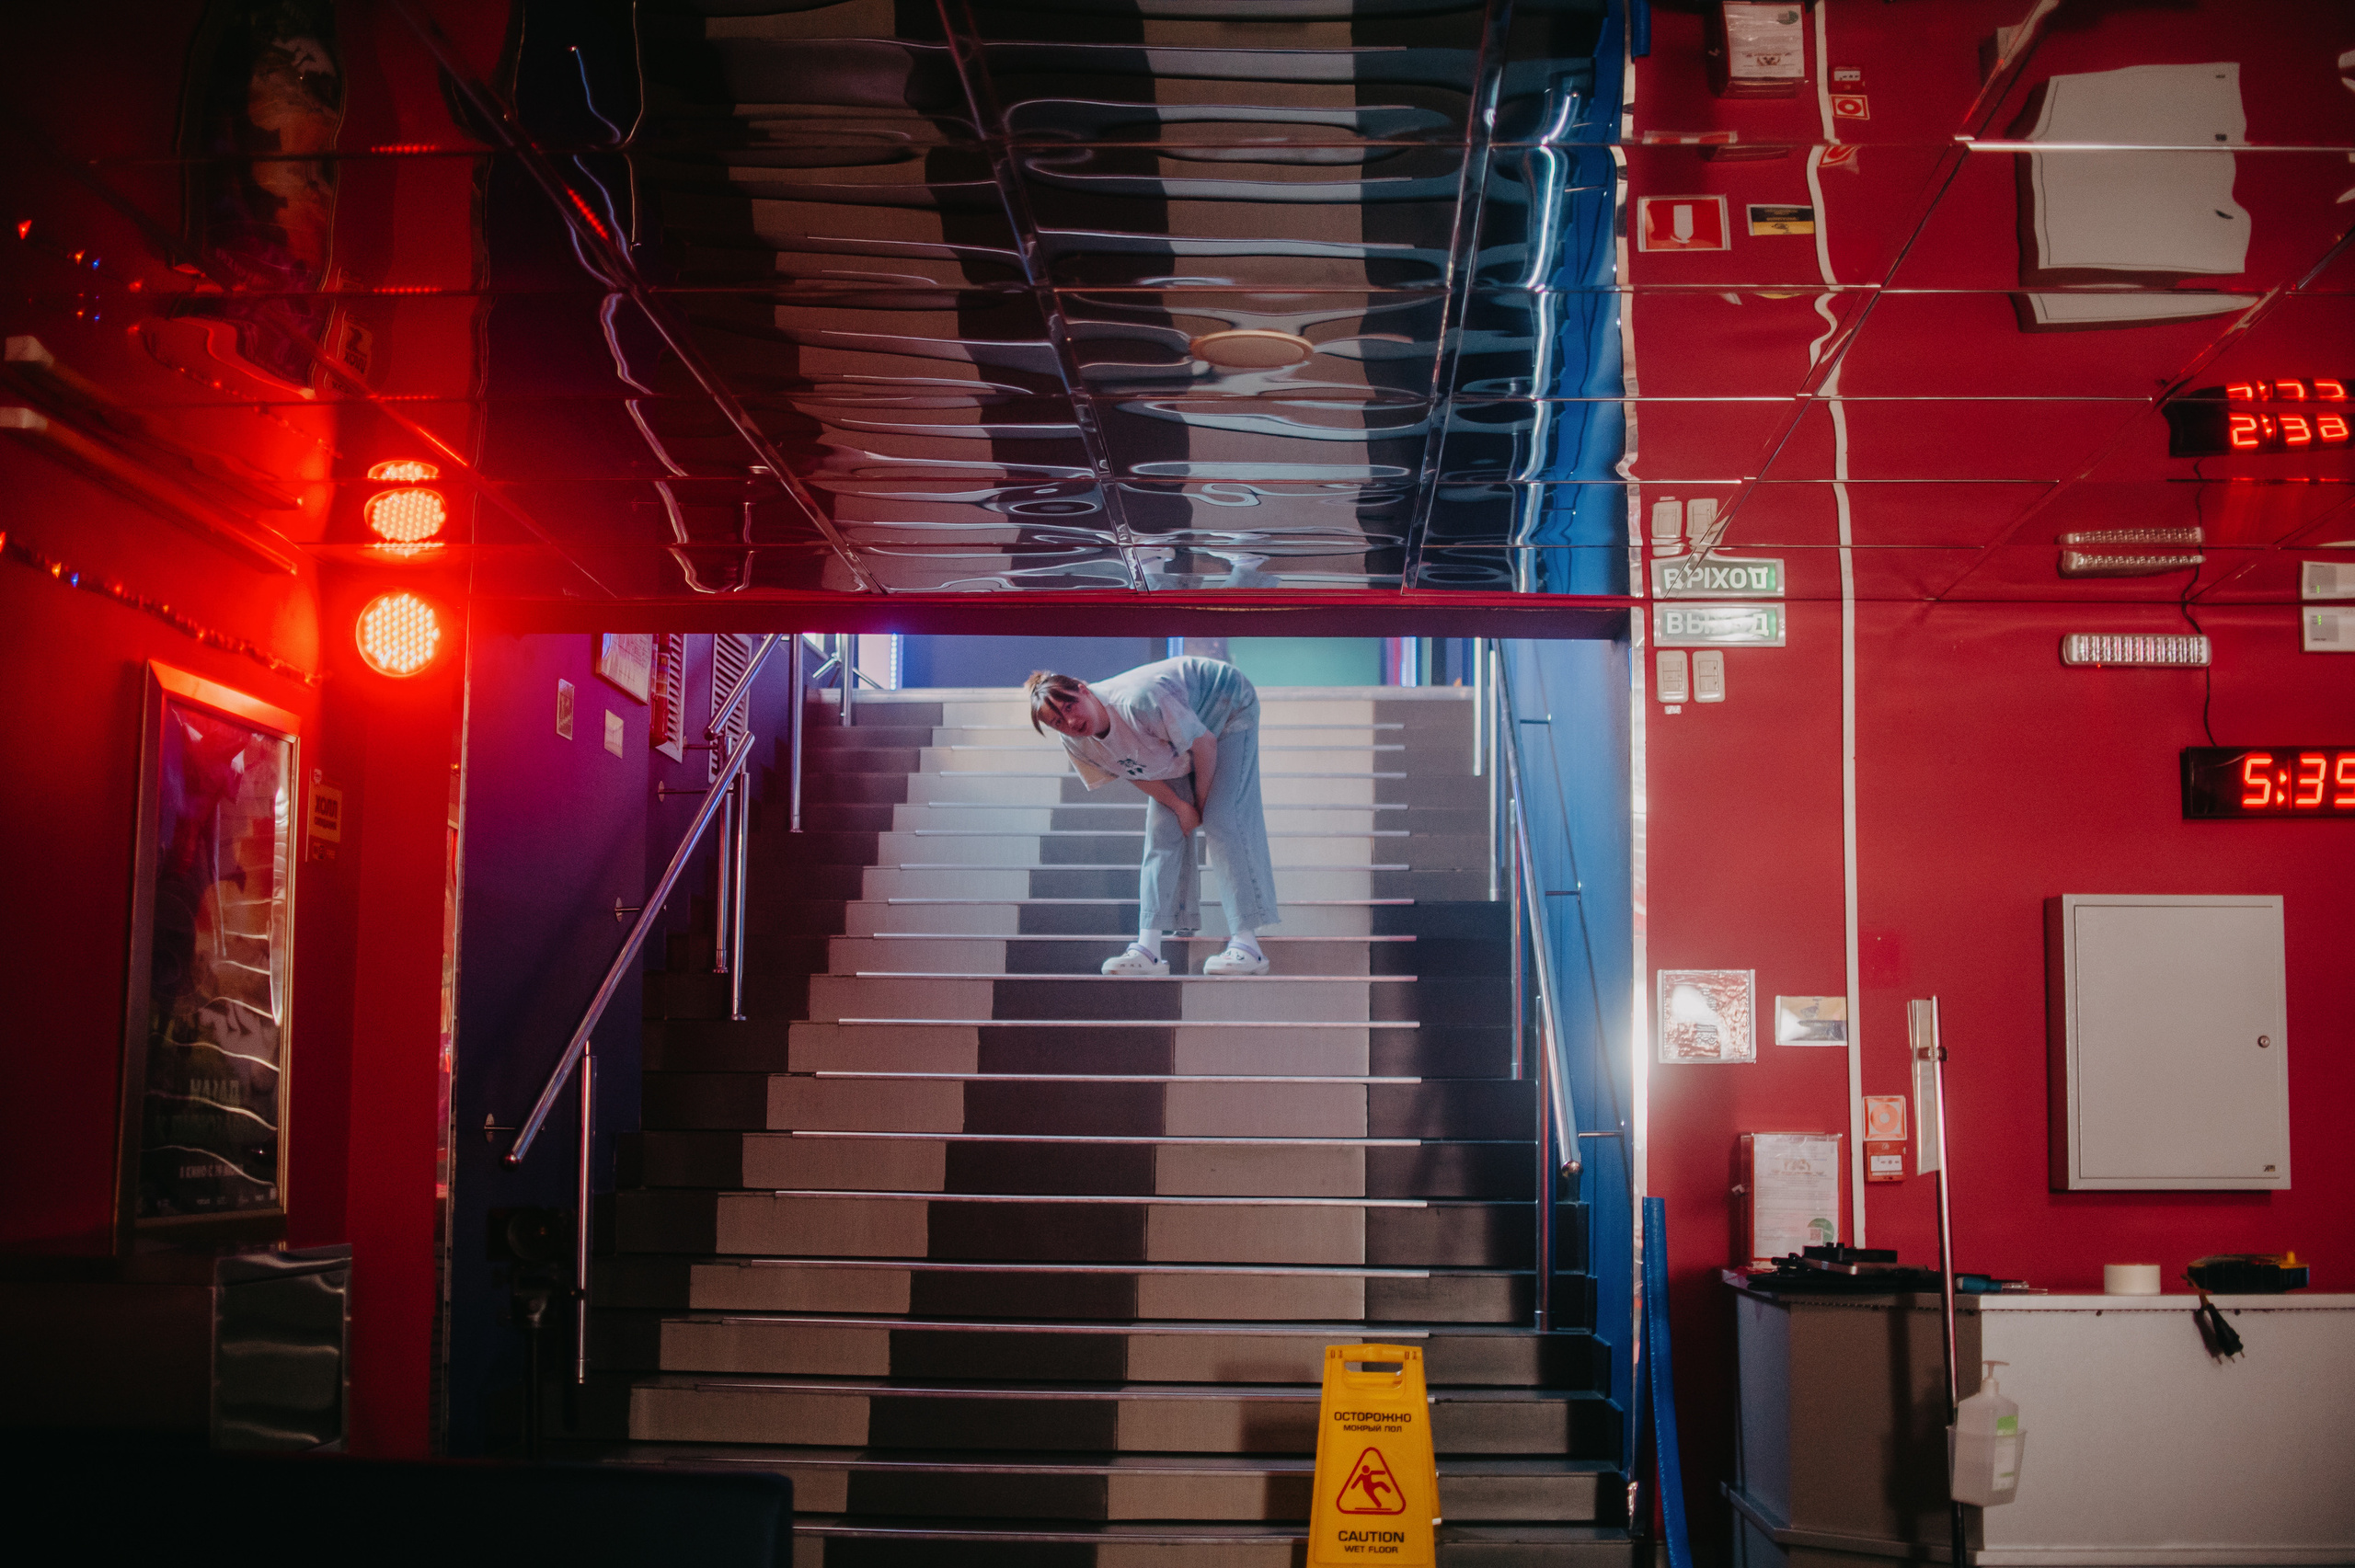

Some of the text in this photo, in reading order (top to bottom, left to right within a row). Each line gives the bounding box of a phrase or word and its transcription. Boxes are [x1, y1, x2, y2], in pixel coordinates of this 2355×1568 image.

[1666, 612, 1769, 636] ВЫД
[1334, 1412, 1412, 1423] ОСТОРОЖНО
[1338, 1530, 1405, 1543] CAUTION
